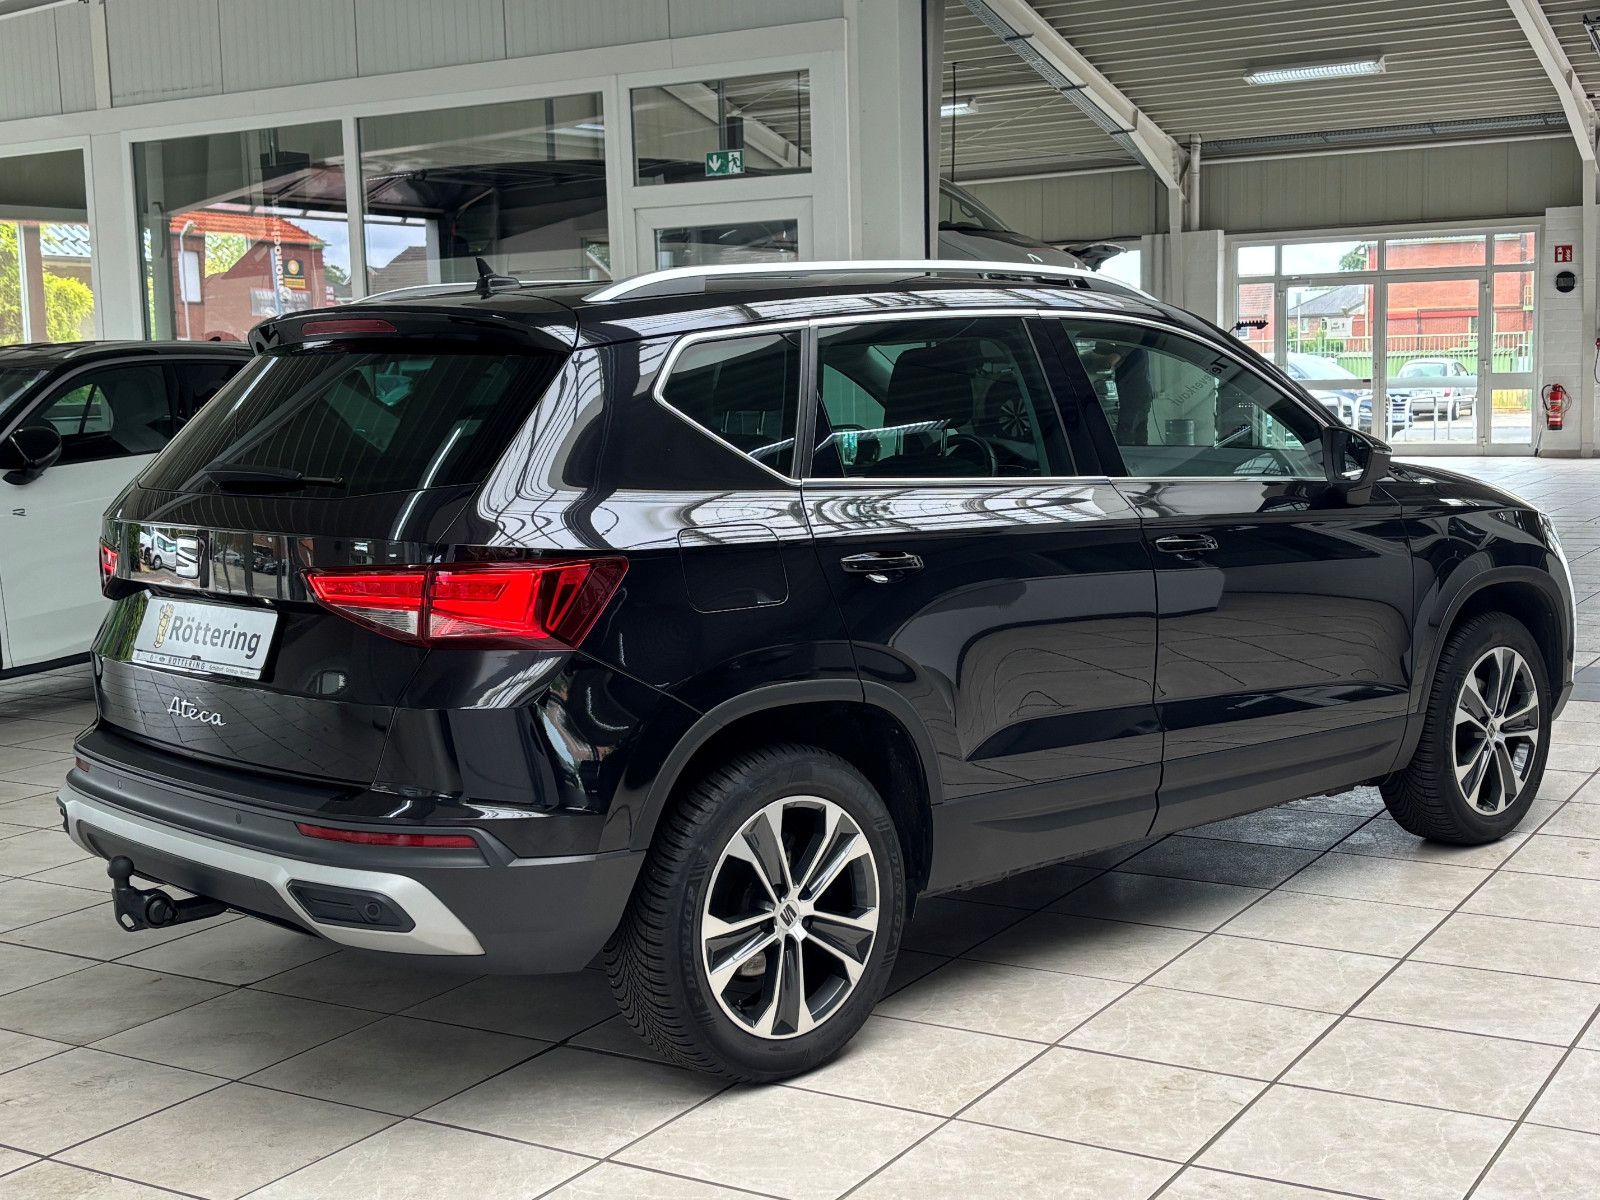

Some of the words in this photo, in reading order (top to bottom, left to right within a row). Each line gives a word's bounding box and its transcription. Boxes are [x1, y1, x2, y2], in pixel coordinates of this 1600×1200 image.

[168, 615, 262, 660] Röttering
[167, 696, 227, 727] Ateca
[681, 885, 696, 989] DUNLOP
